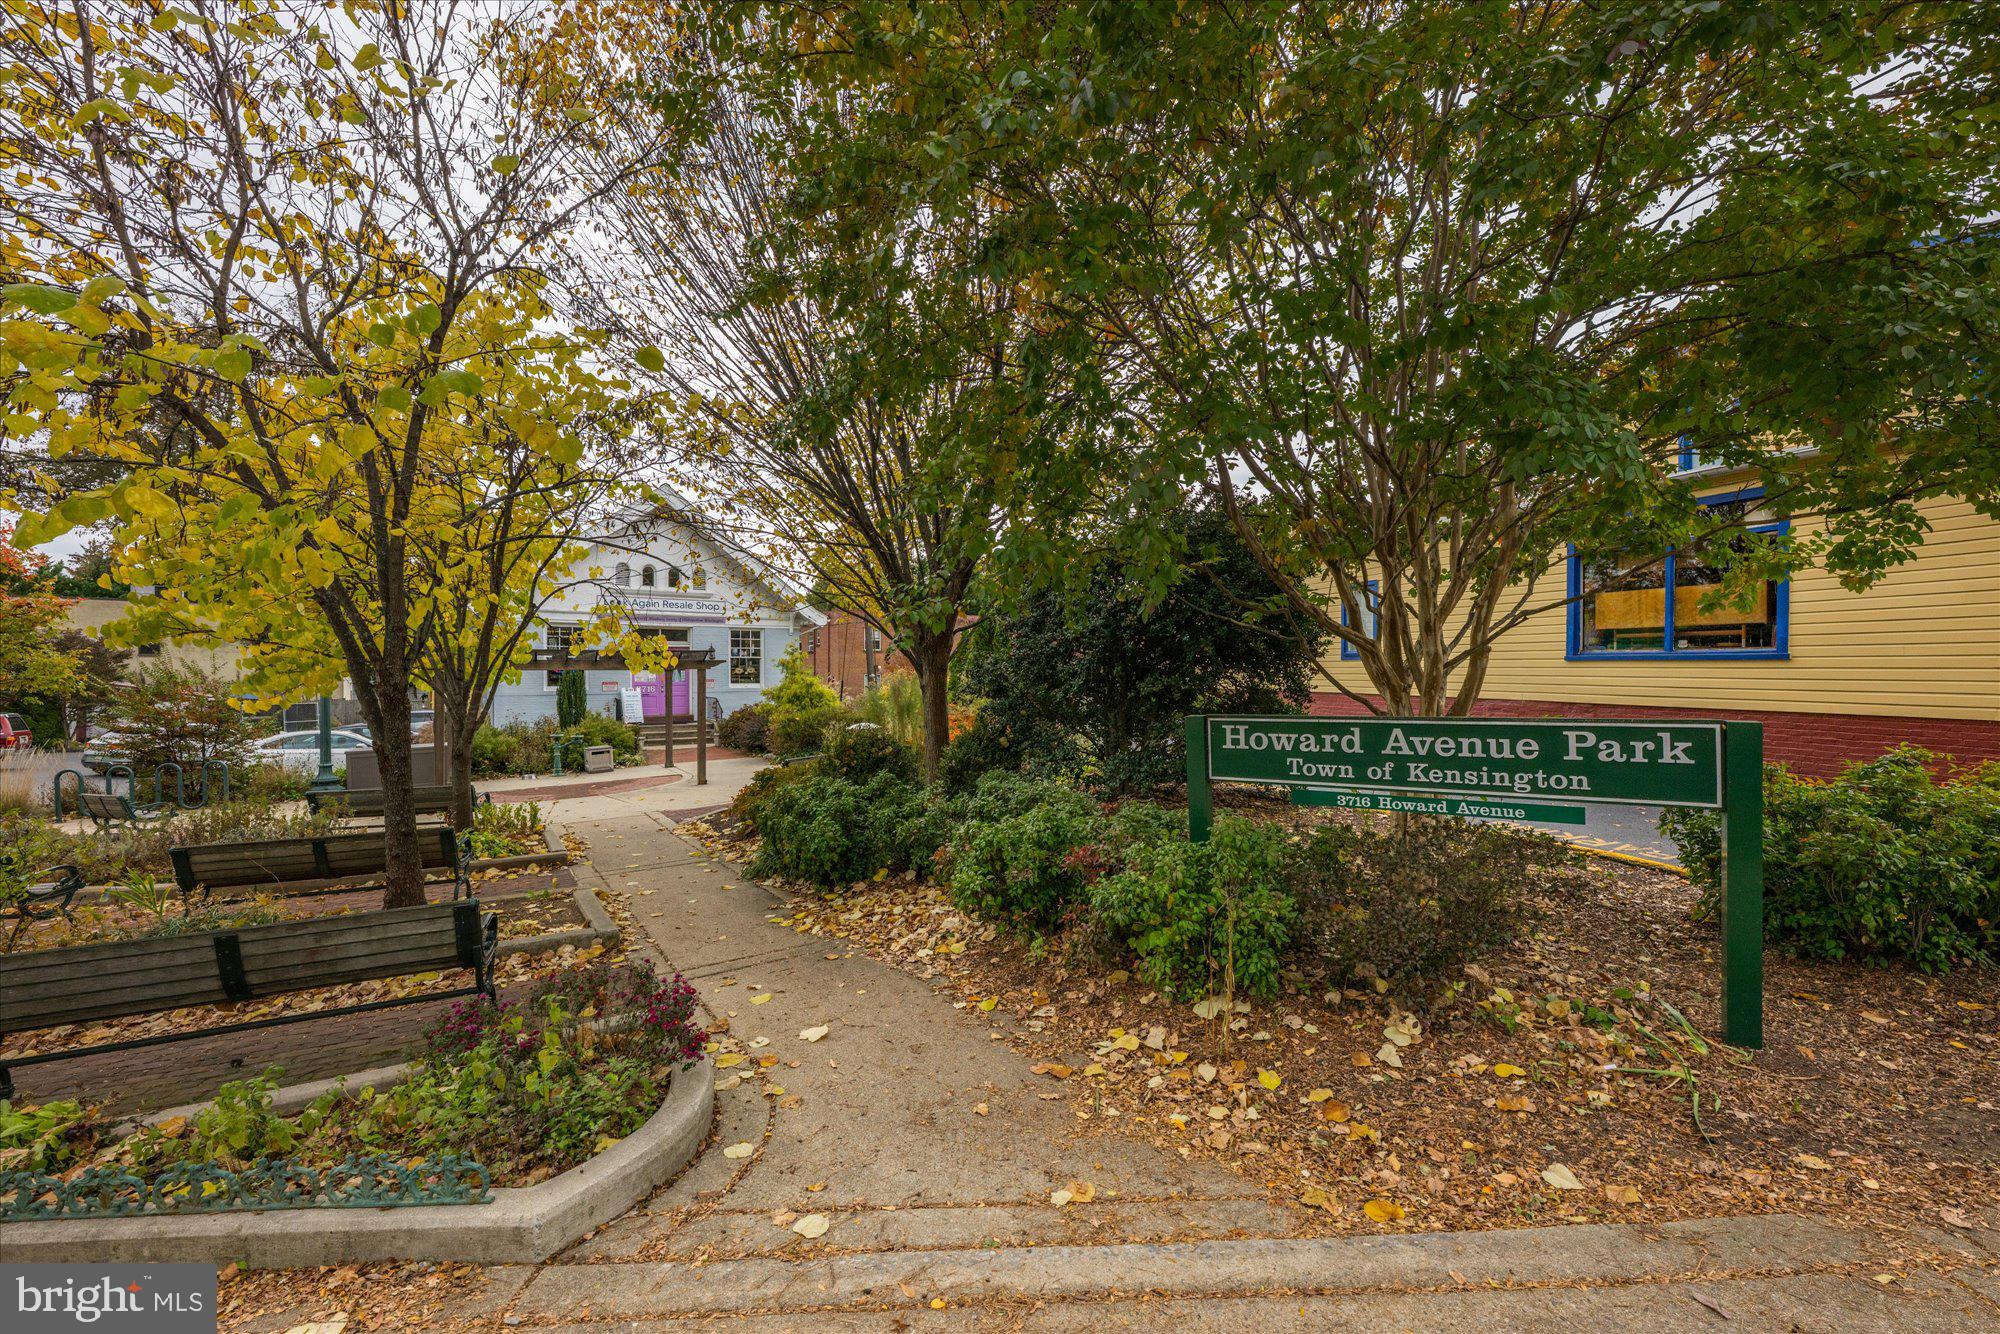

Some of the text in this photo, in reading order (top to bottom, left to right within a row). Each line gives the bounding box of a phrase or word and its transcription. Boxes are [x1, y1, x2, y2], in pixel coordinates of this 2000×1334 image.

[632, 598, 660, 609] Again
[663, 600, 694, 610] Resale
[696, 601, 720, 612] Shop
[1222, 725, 1695, 764] Howard Avenue Park
[1287, 757, 1591, 793] Town of Kensington
[1337, 795, 1527, 819] 3716 Howard Avenue
